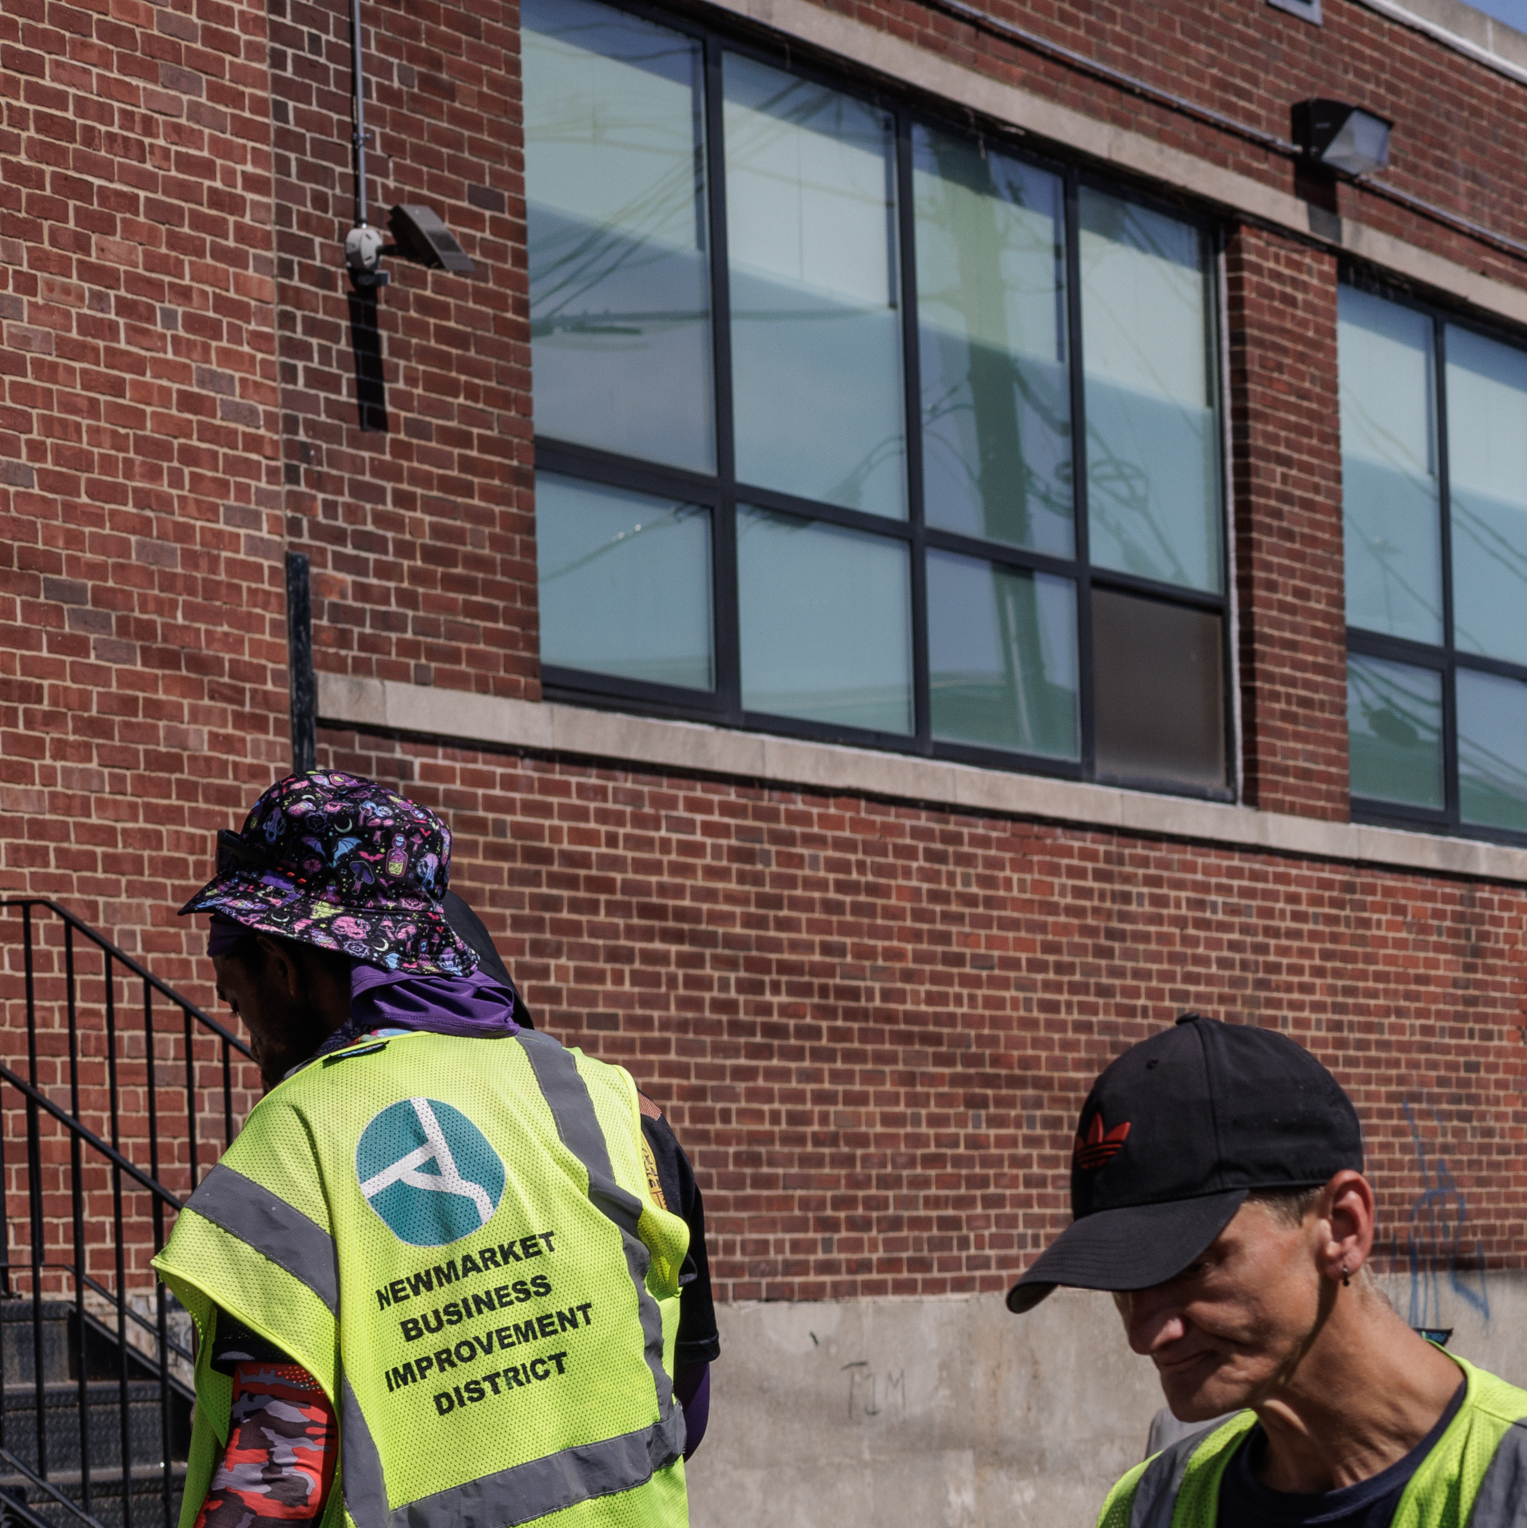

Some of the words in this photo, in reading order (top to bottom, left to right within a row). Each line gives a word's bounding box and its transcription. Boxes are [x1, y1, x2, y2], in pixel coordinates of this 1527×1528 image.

[375, 1230, 555, 1311] NEWMARKET
[400, 1274, 552, 1342] BUSINESS
[385, 1303, 592, 1392] IMPROVEMENT
[433, 1351, 567, 1416] DISTRICT
